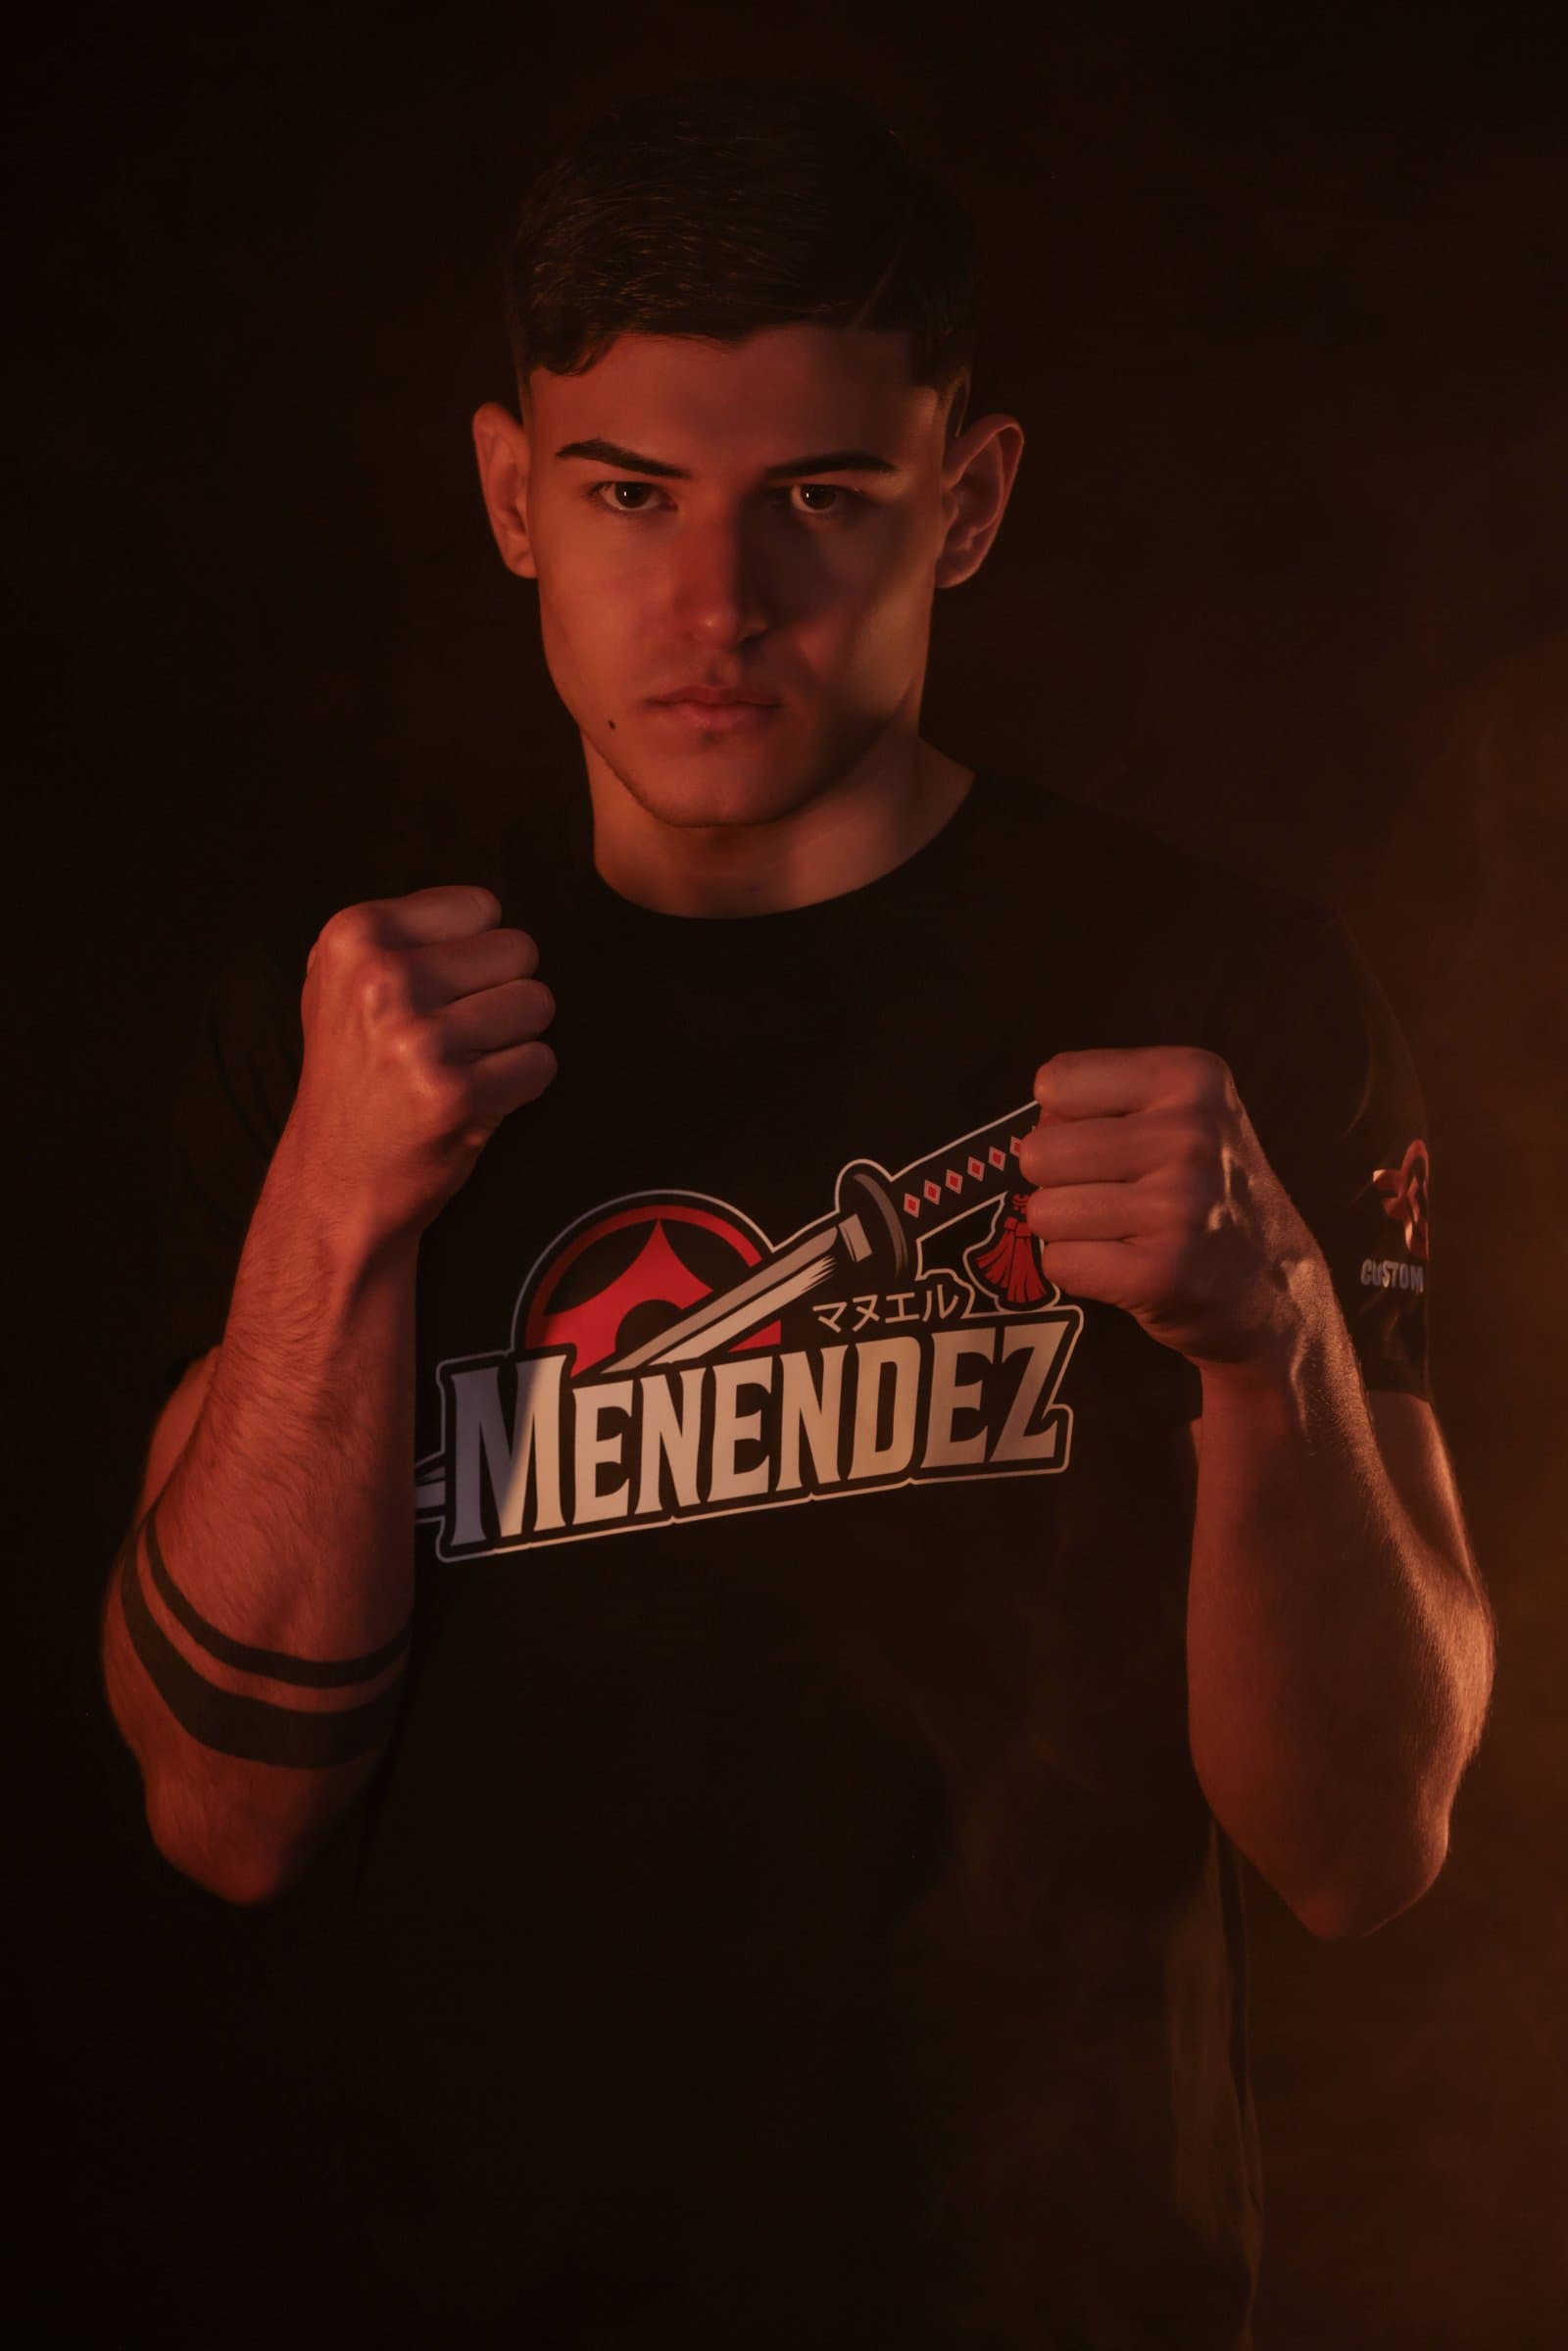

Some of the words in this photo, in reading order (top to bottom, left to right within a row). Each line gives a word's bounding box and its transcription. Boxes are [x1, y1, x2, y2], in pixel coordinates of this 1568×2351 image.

[1360, 1258, 1424, 1294] CUSTOM
[812, 1283, 959, 1334] マヌエル
[450, 1320, 1071, 1546] MENENDEZ
